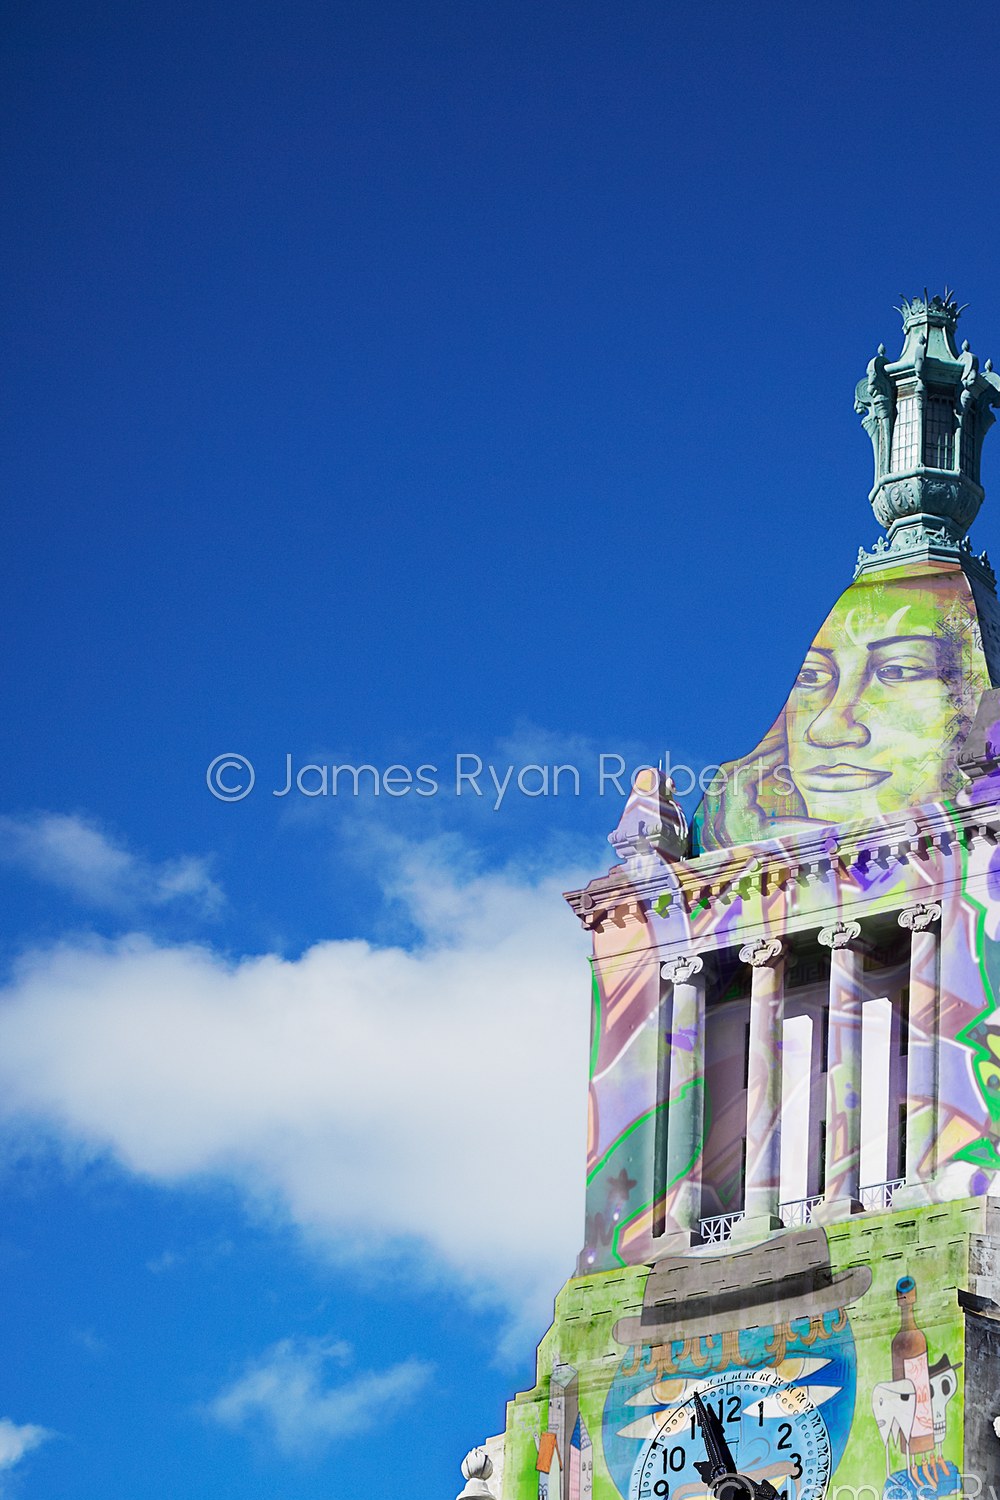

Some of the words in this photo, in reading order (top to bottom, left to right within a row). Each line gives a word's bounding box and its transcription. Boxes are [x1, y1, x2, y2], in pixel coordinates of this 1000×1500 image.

[758, 1400, 765, 1427] 1
[777, 1422, 794, 1450] 2
[662, 1446, 686, 1474] 10
[790, 1452, 804, 1480] 3
